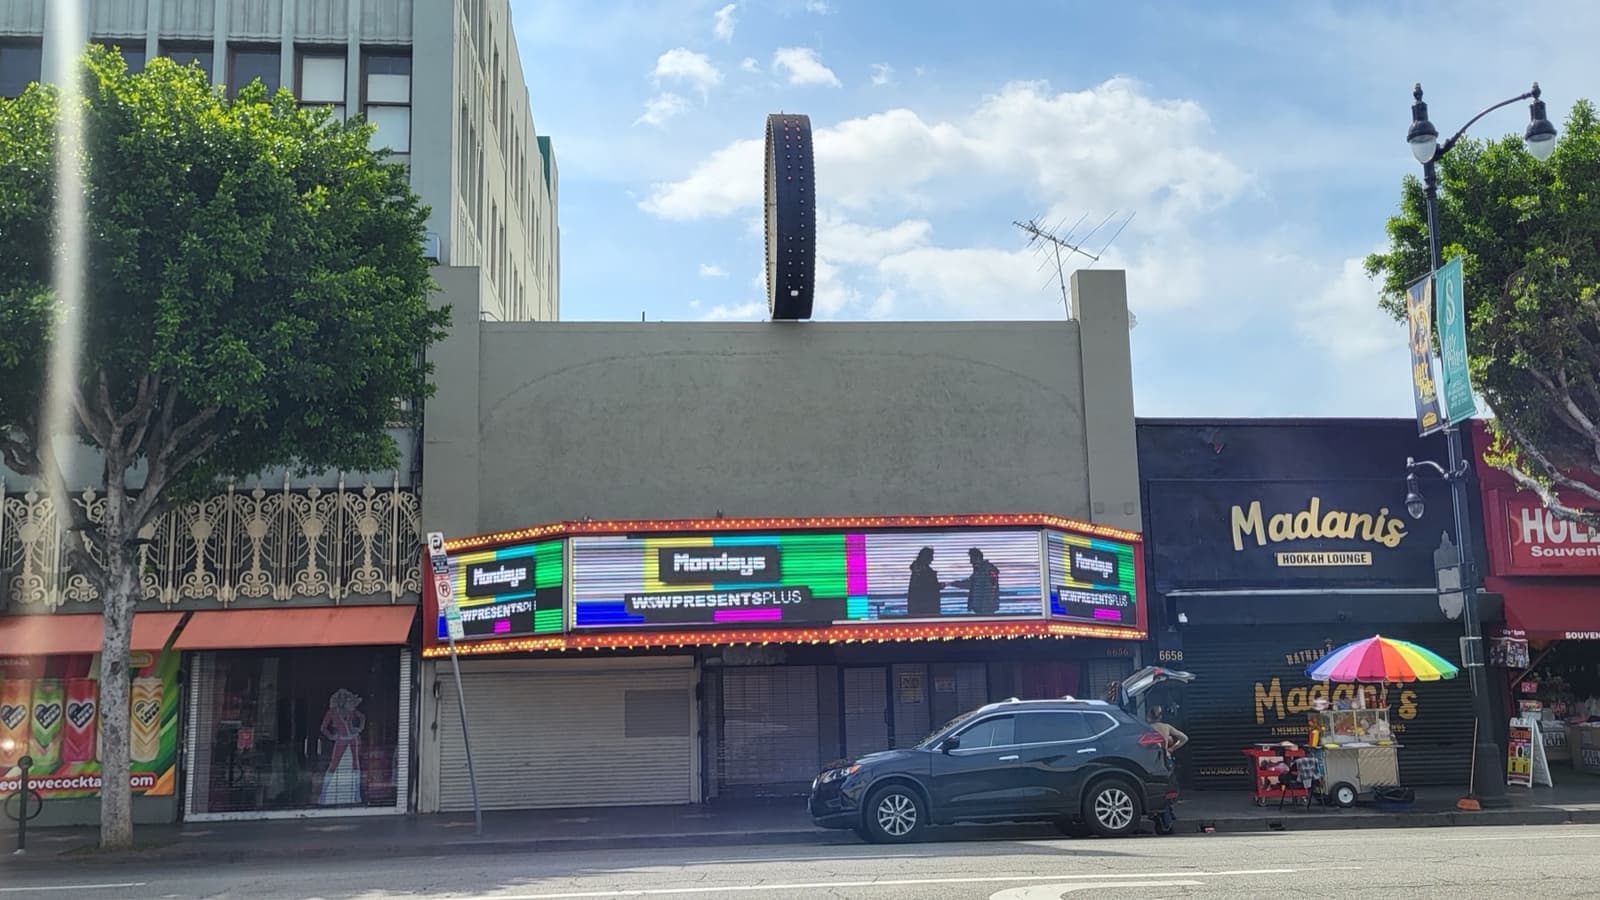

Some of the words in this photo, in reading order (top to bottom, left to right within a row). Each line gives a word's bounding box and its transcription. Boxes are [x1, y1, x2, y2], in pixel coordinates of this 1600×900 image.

[1231, 497, 1408, 551] Madanis
[673, 552, 766, 576] Mondays
[1282, 554, 1325, 565] HOOKAH
[1327, 554, 1367, 564] LOUNGE
[473, 565, 527, 588] Mondays
[1159, 650, 1183, 661] 6658
